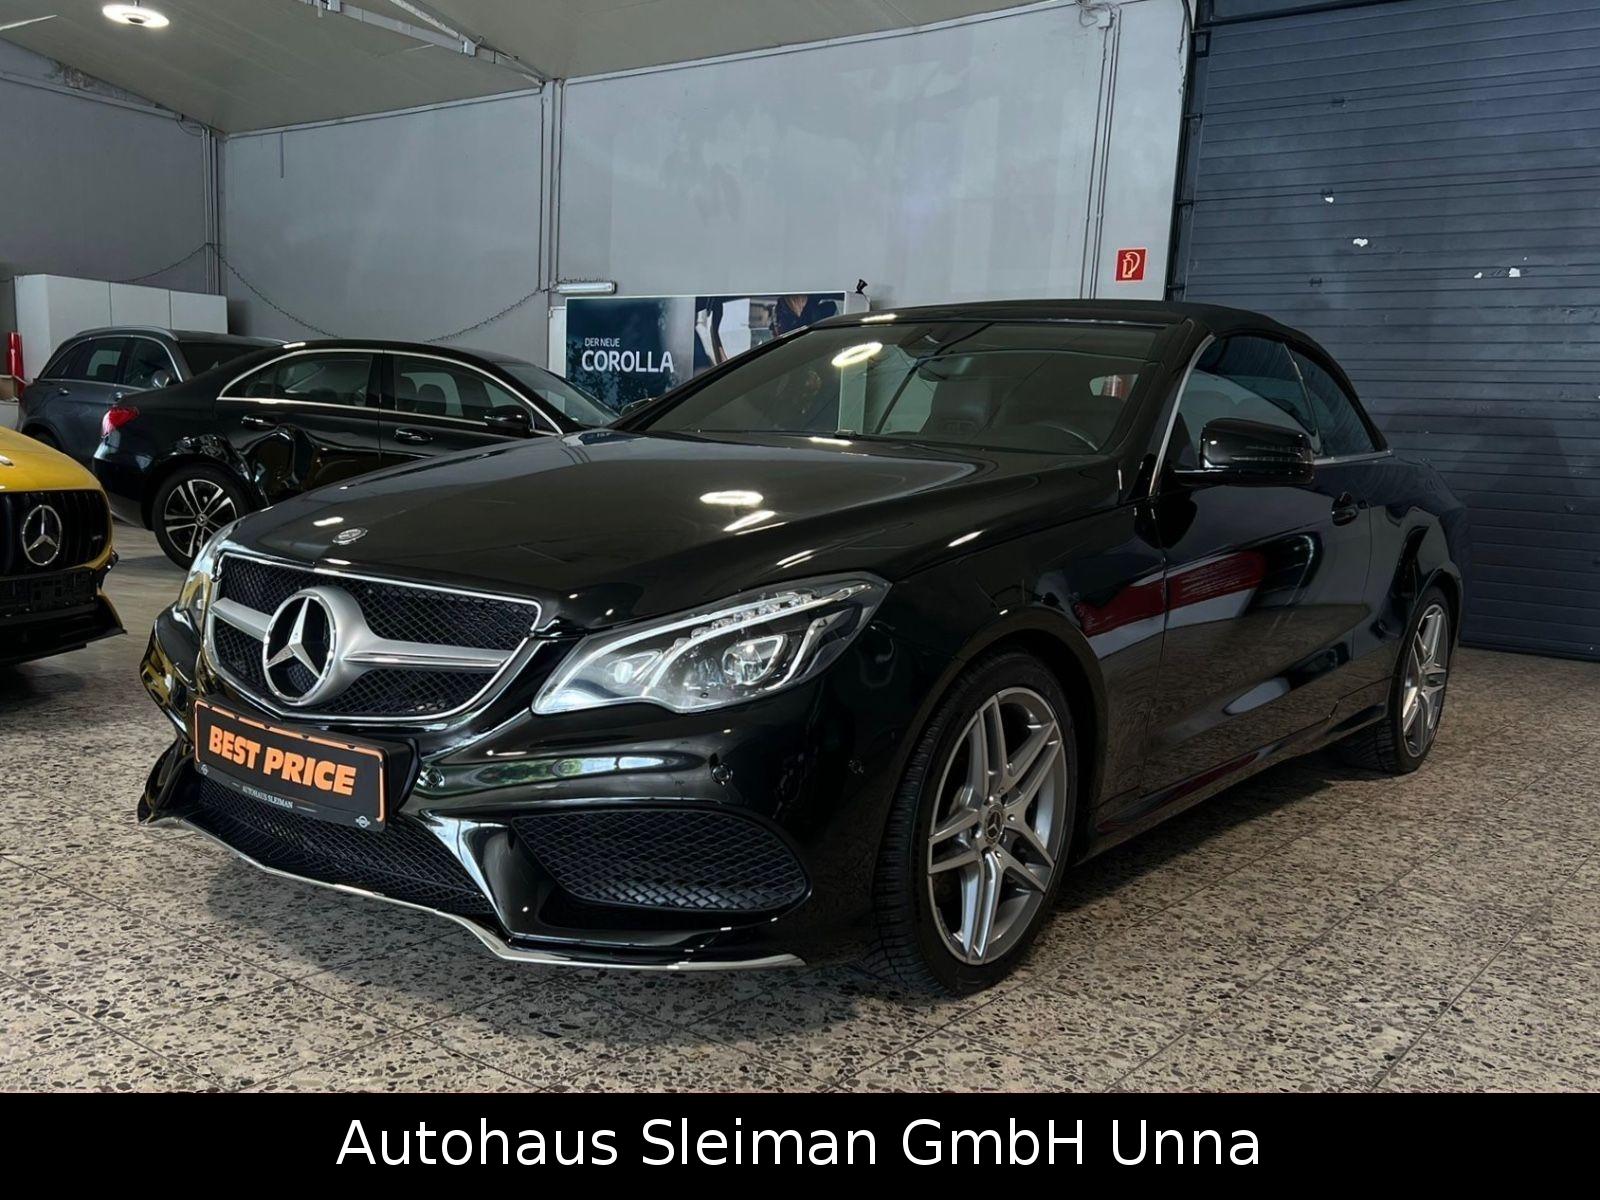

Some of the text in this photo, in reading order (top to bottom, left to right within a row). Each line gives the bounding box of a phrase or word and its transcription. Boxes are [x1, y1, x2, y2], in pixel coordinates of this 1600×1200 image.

[584, 337, 620, 347] DER NEUE
[581, 350, 674, 373] COROLLA
[208, 725, 357, 796] BEST PRICE
